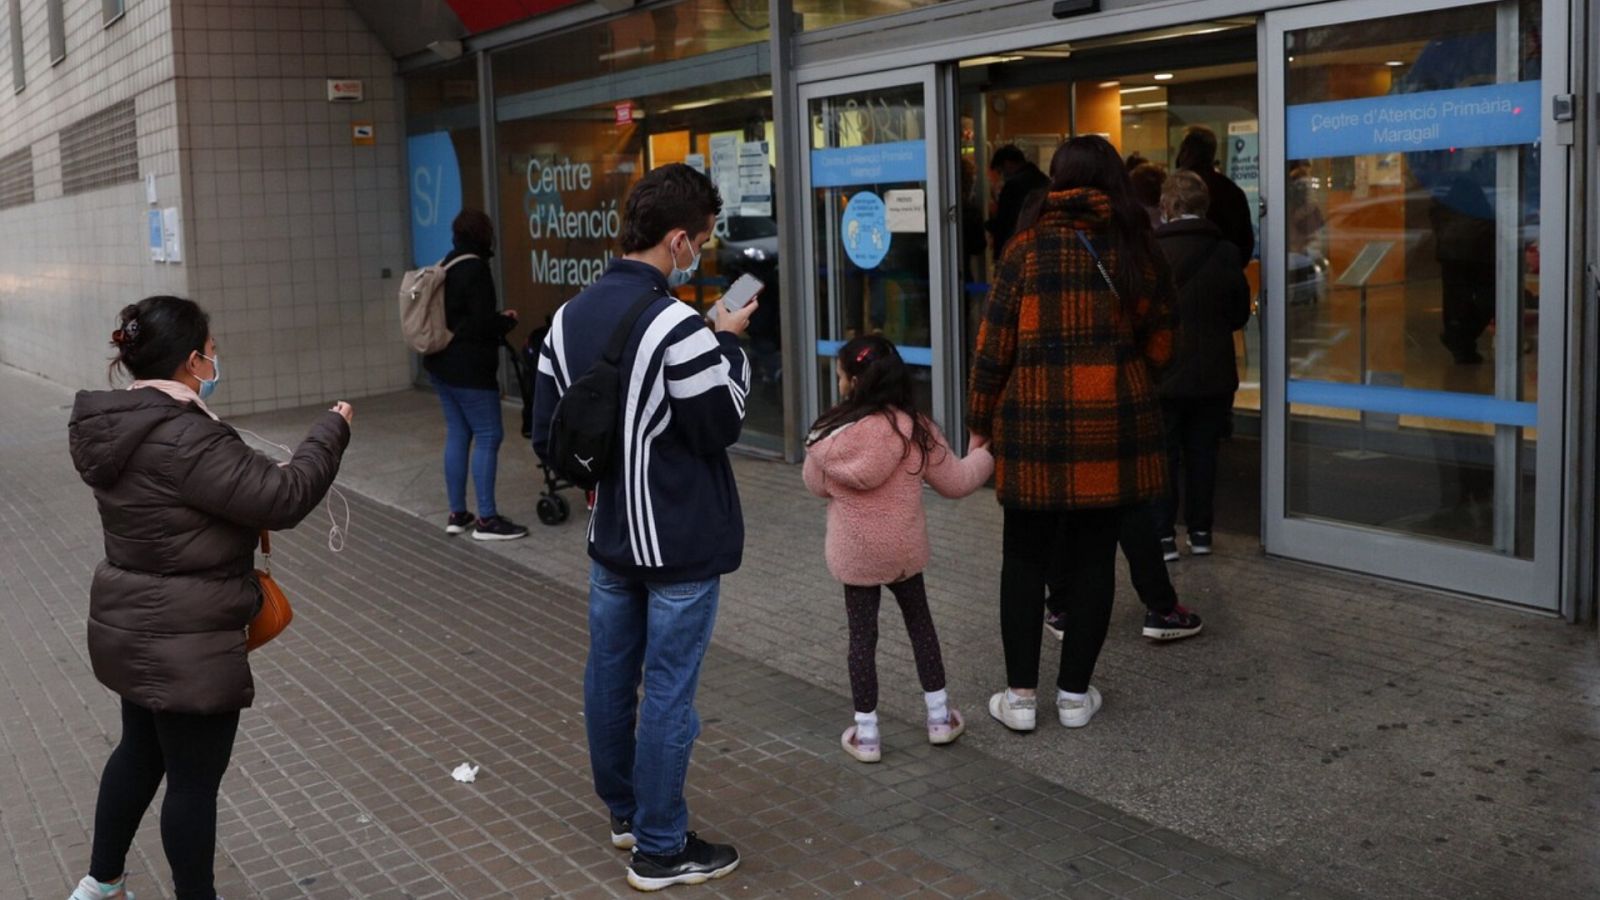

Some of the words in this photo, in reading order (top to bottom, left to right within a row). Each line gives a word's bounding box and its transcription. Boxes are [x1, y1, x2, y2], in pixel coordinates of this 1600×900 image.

[1311, 112, 1359, 130] Centre
[1363, 103, 1437, 125] d'Atenció
[1442, 98, 1512, 117] Primària
[1373, 124, 1440, 145] Maragall
[527, 158, 592, 194] Centre
[529, 199, 621, 239] d'Atenció
[531, 249, 613, 291] Maragal
